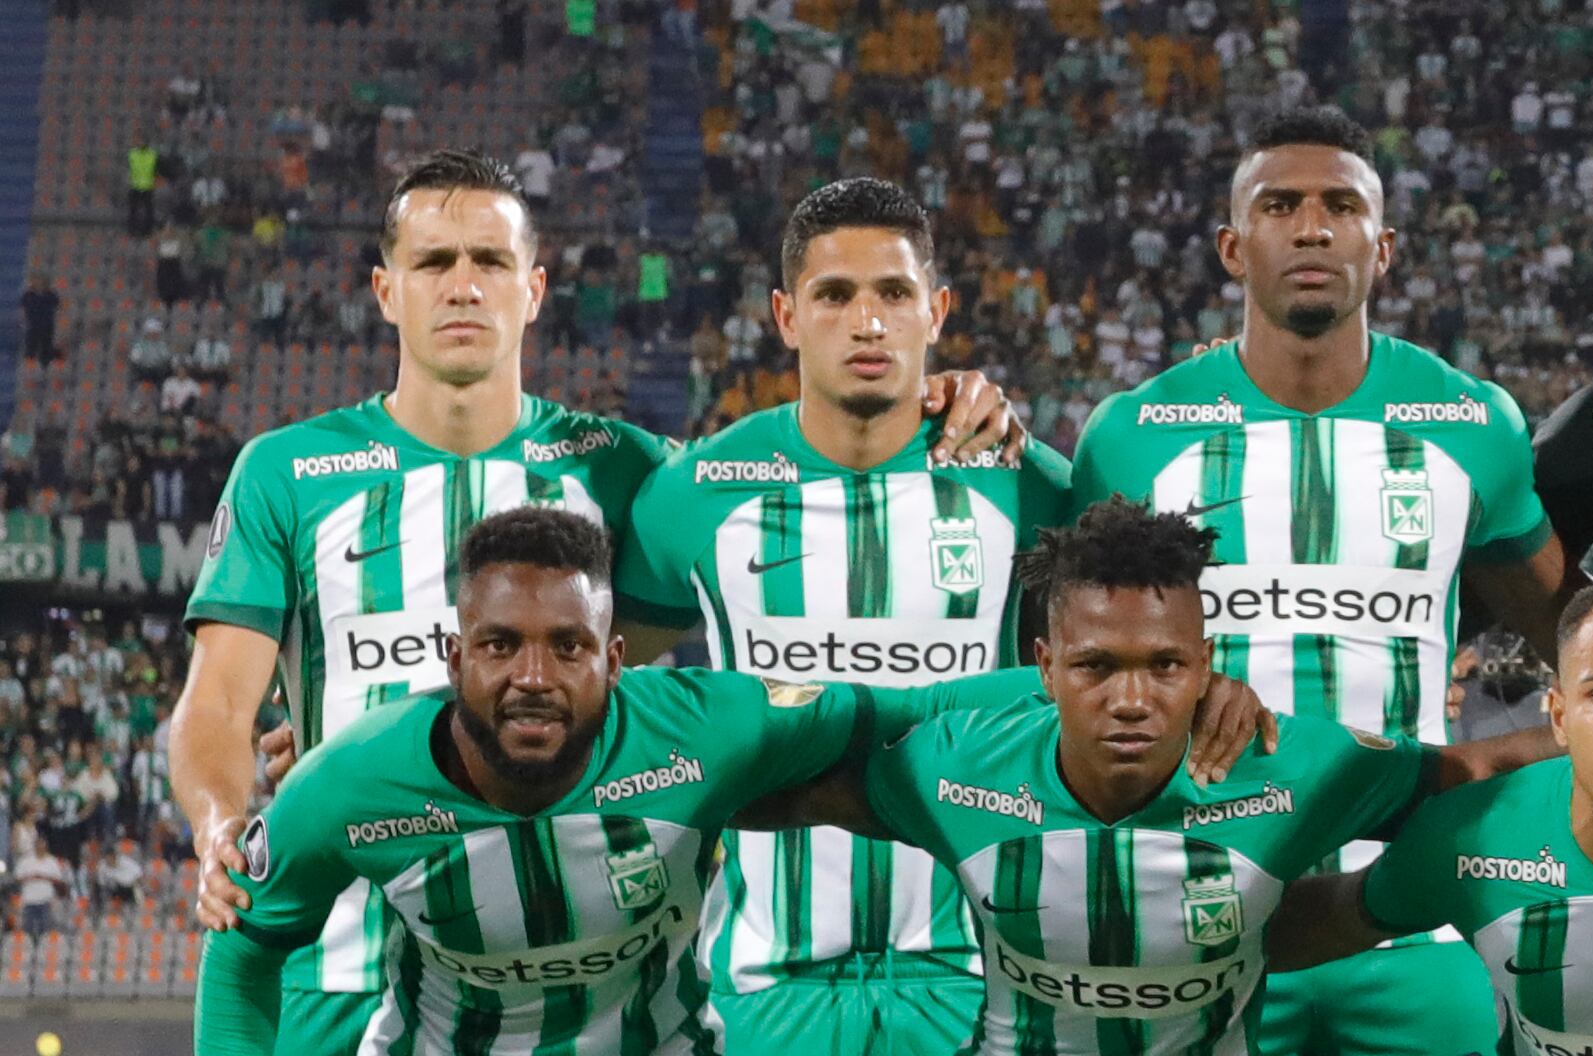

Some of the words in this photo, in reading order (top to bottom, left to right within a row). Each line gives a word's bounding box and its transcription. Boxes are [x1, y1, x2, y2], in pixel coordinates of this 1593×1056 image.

[747, 629, 987, 674] betsson
[428, 904, 682, 984] betsson
[998, 951, 1246, 1009] betsson
